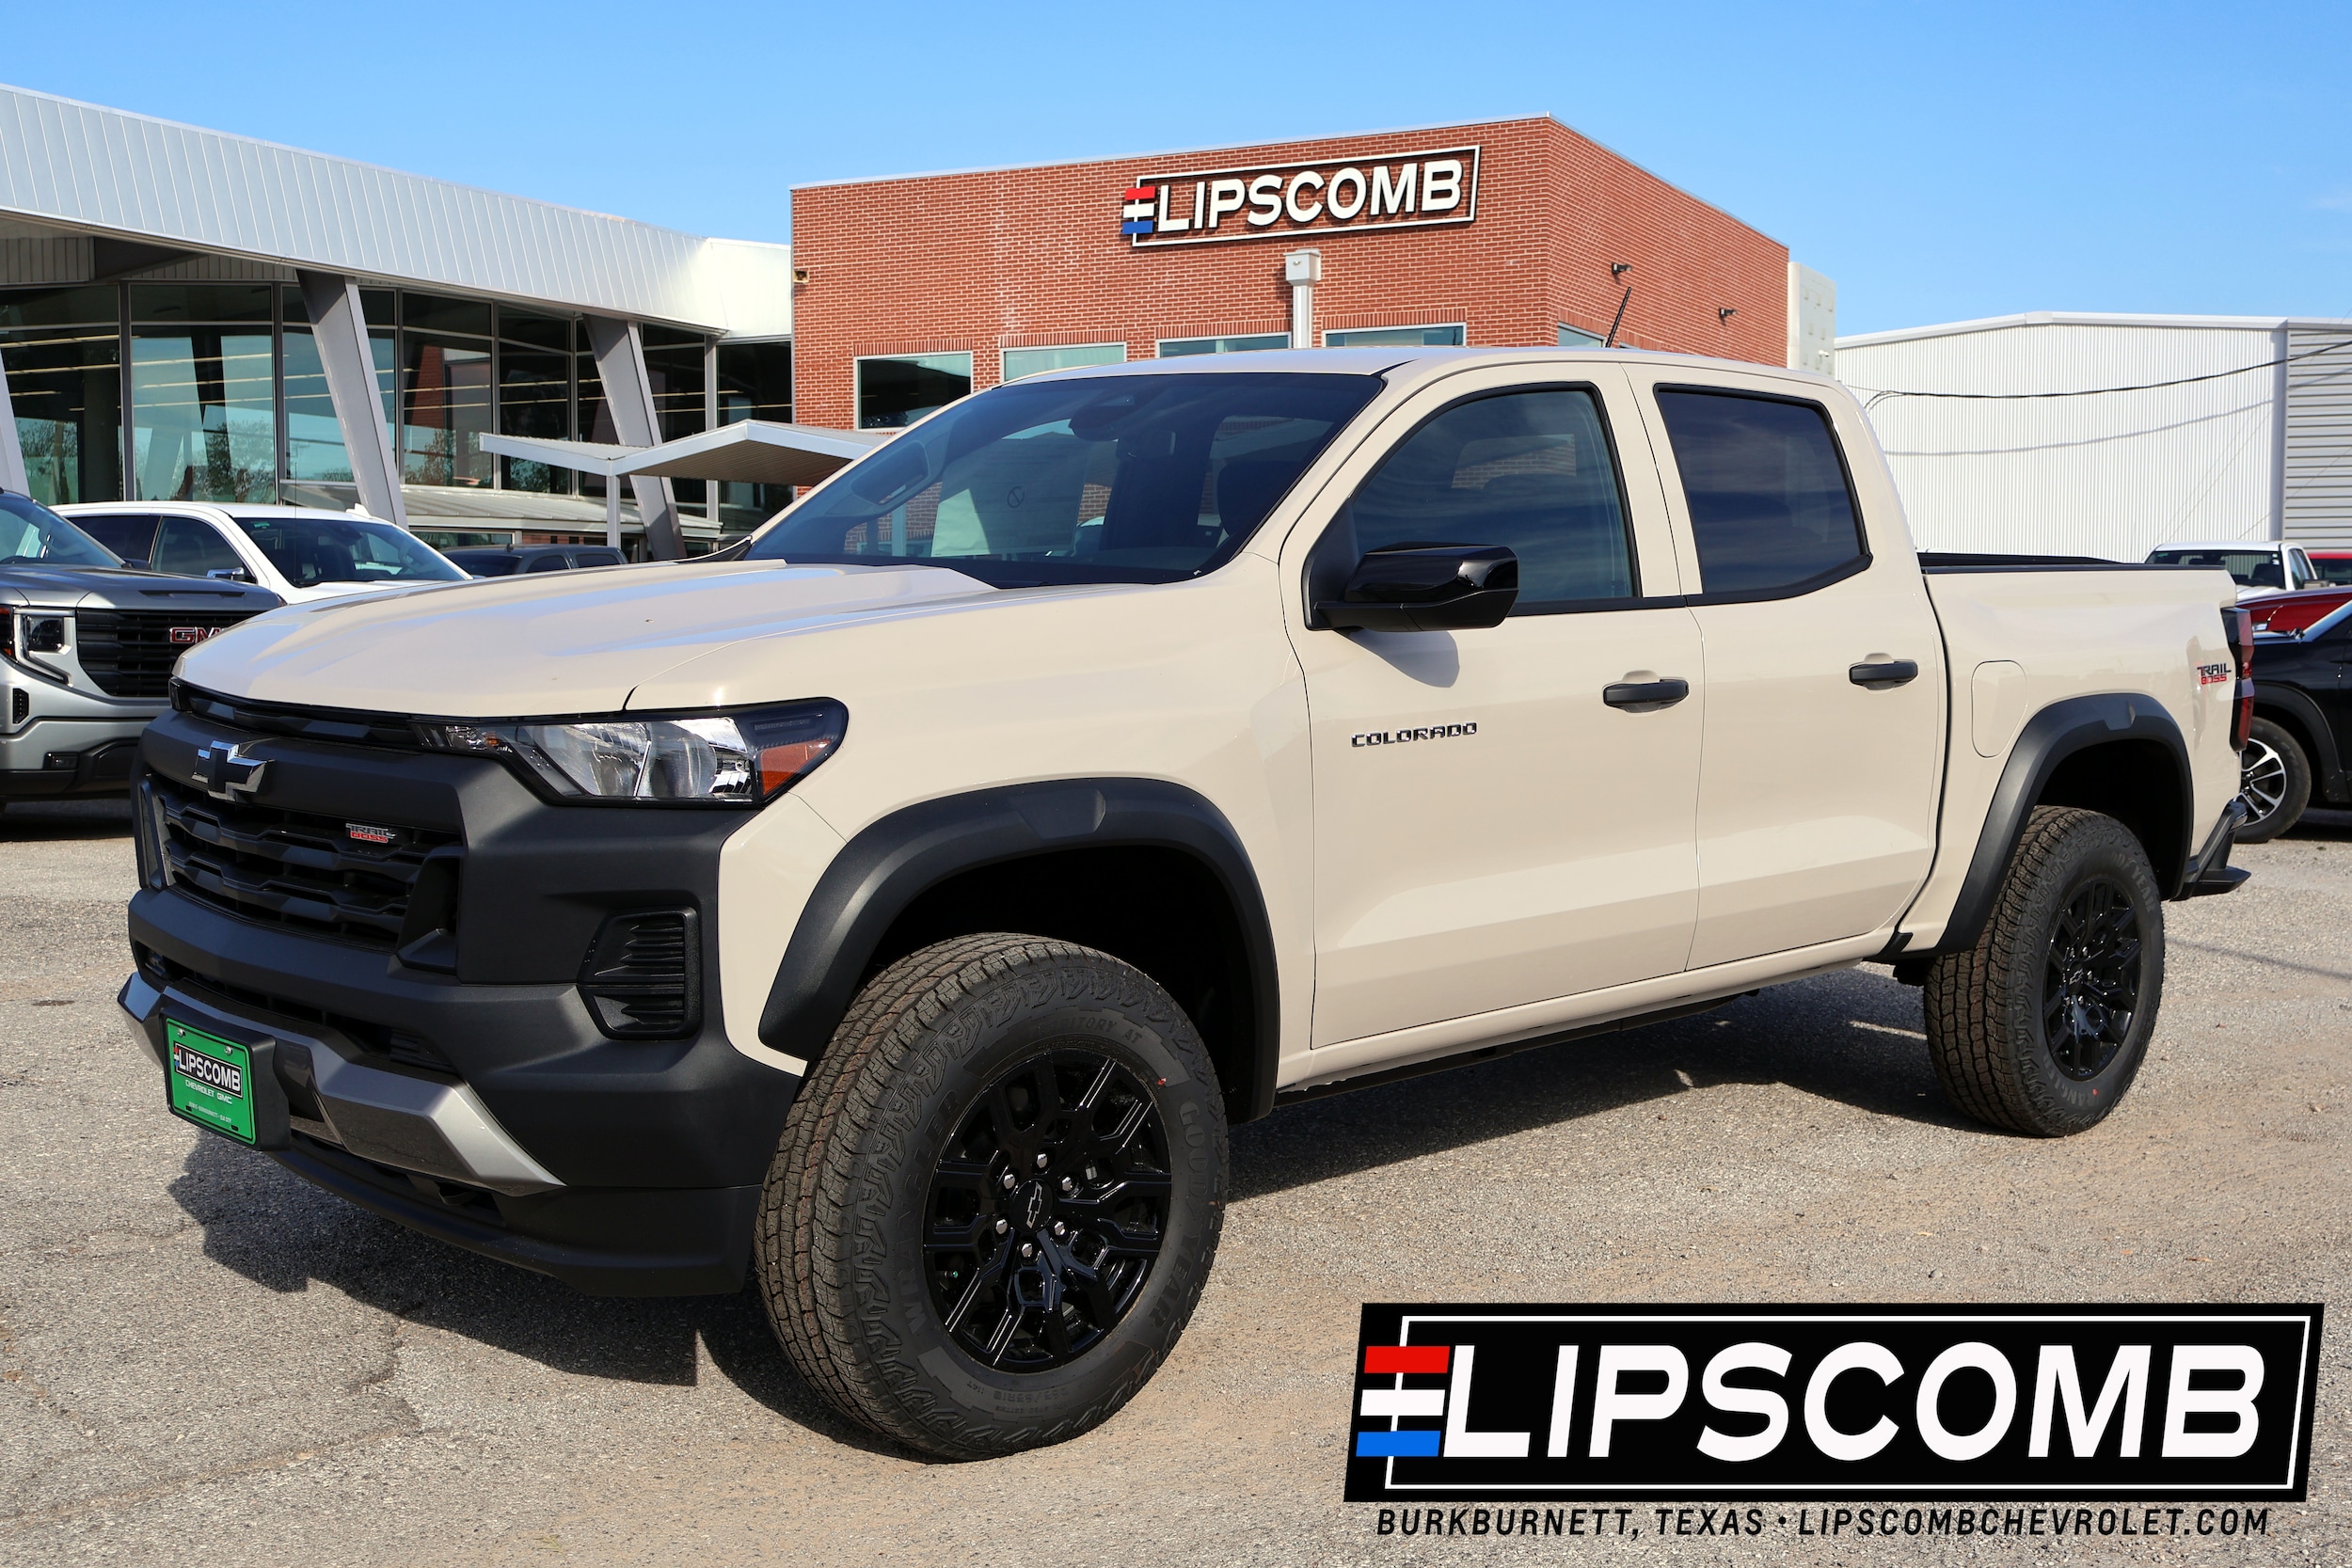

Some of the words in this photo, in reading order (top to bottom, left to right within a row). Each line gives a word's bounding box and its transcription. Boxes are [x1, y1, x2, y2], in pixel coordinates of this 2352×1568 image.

[1157, 159, 1464, 233] LIPSCOMB
[169, 626, 226, 643] GM
[2197, 662, 2232, 676] TRAIL
[2201, 673, 2228, 685] BOSS
[1351, 721, 1477, 748] COLORADO
[345, 823, 396, 839] TRAIL
[1029, 1016, 1118, 1039] TRITORY
[179, 1049, 241, 1091] LIPSCOMB
[216, 1092, 232, 1104] GMC
